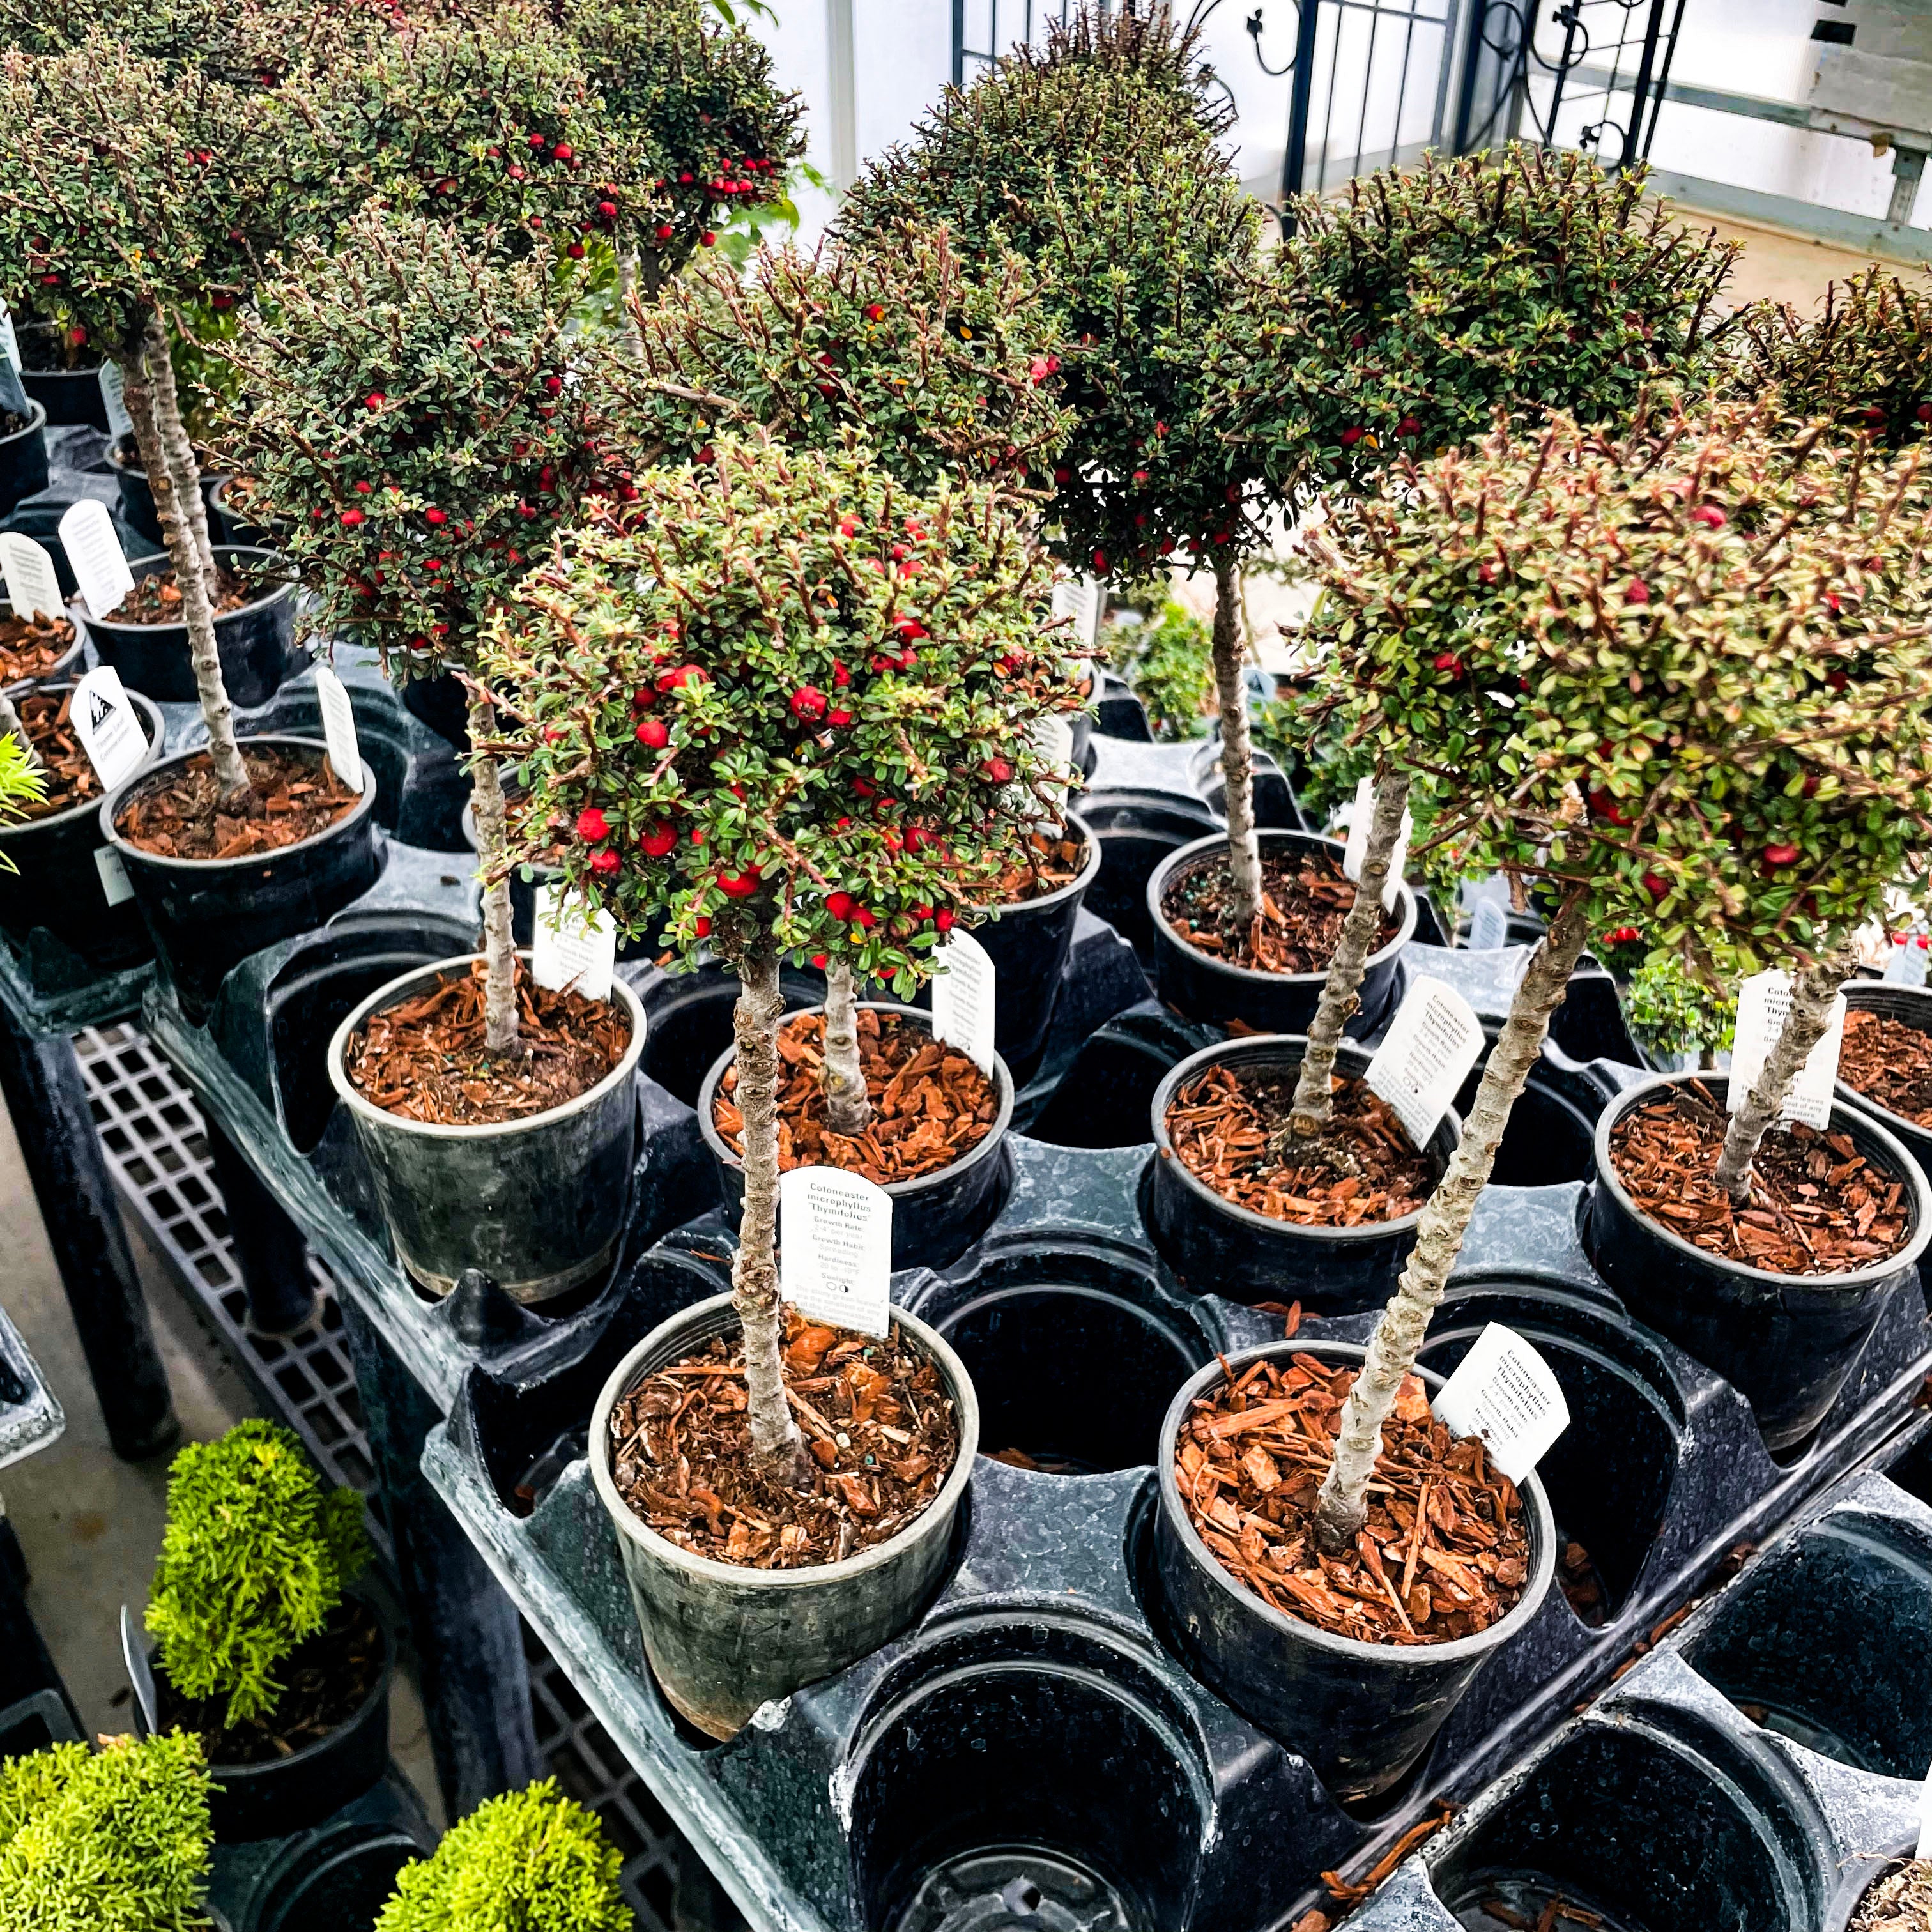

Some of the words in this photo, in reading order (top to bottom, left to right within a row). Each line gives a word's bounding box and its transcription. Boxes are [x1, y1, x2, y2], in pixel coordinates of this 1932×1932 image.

[1432, 994, 1469, 1034] Cotoneaster
[807, 1193, 871, 1212] microphyllus
[810, 1182, 869, 1201] Cotoneaster
[813, 1216, 842, 1227] Growth
[812, 1233, 841, 1245] Growth
[1492, 1376, 1513, 1405] Growth
[1499, 1355, 1545, 1415] microphyllus
[1507, 1349, 1551, 1405] Cotoneaster
[1480, 1388, 1502, 1417] Growth
